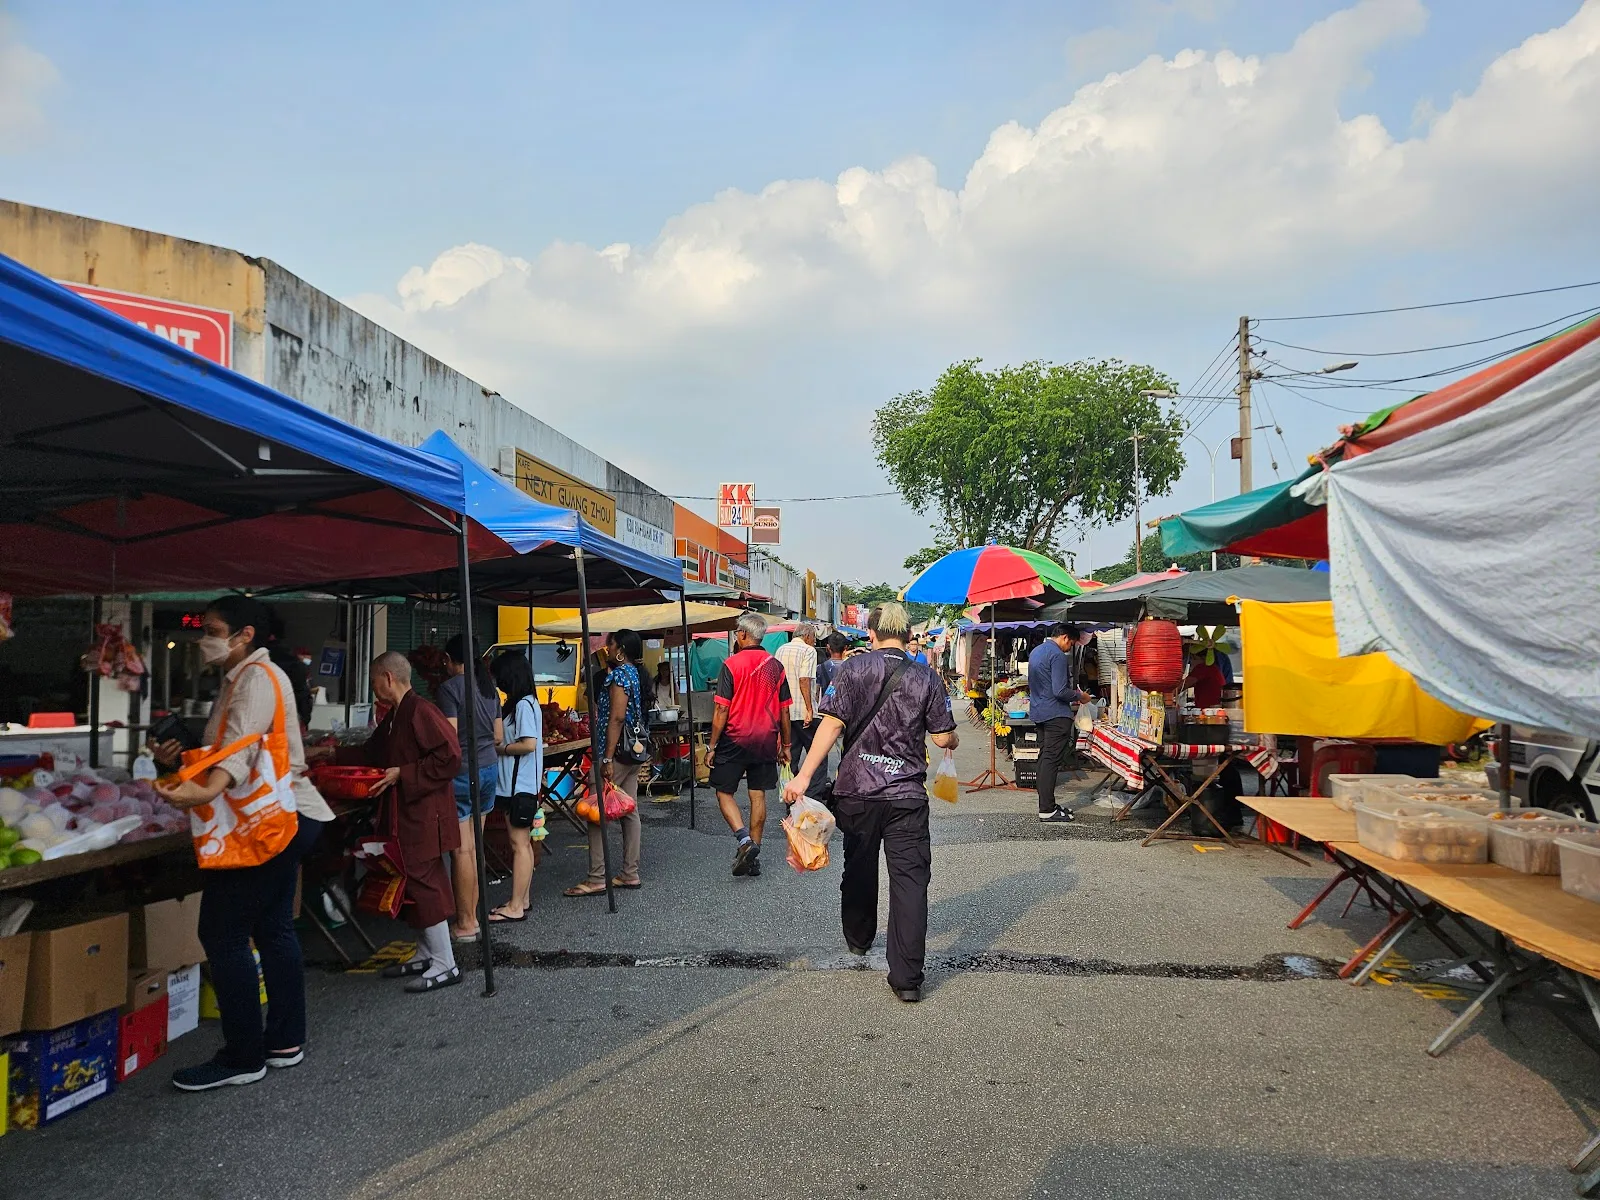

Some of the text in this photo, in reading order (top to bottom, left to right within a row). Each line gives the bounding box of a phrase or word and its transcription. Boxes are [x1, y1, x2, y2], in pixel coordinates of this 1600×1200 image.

[137, 321, 201, 353] NT
[517, 457, 531, 471] KAFE
[525, 473, 611, 524] NEXT GUANG ZHOU
[722, 484, 752, 505] KK
[732, 505, 742, 525] 24
[699, 545, 720, 586] KK
[858, 752, 905, 769] ymphony
